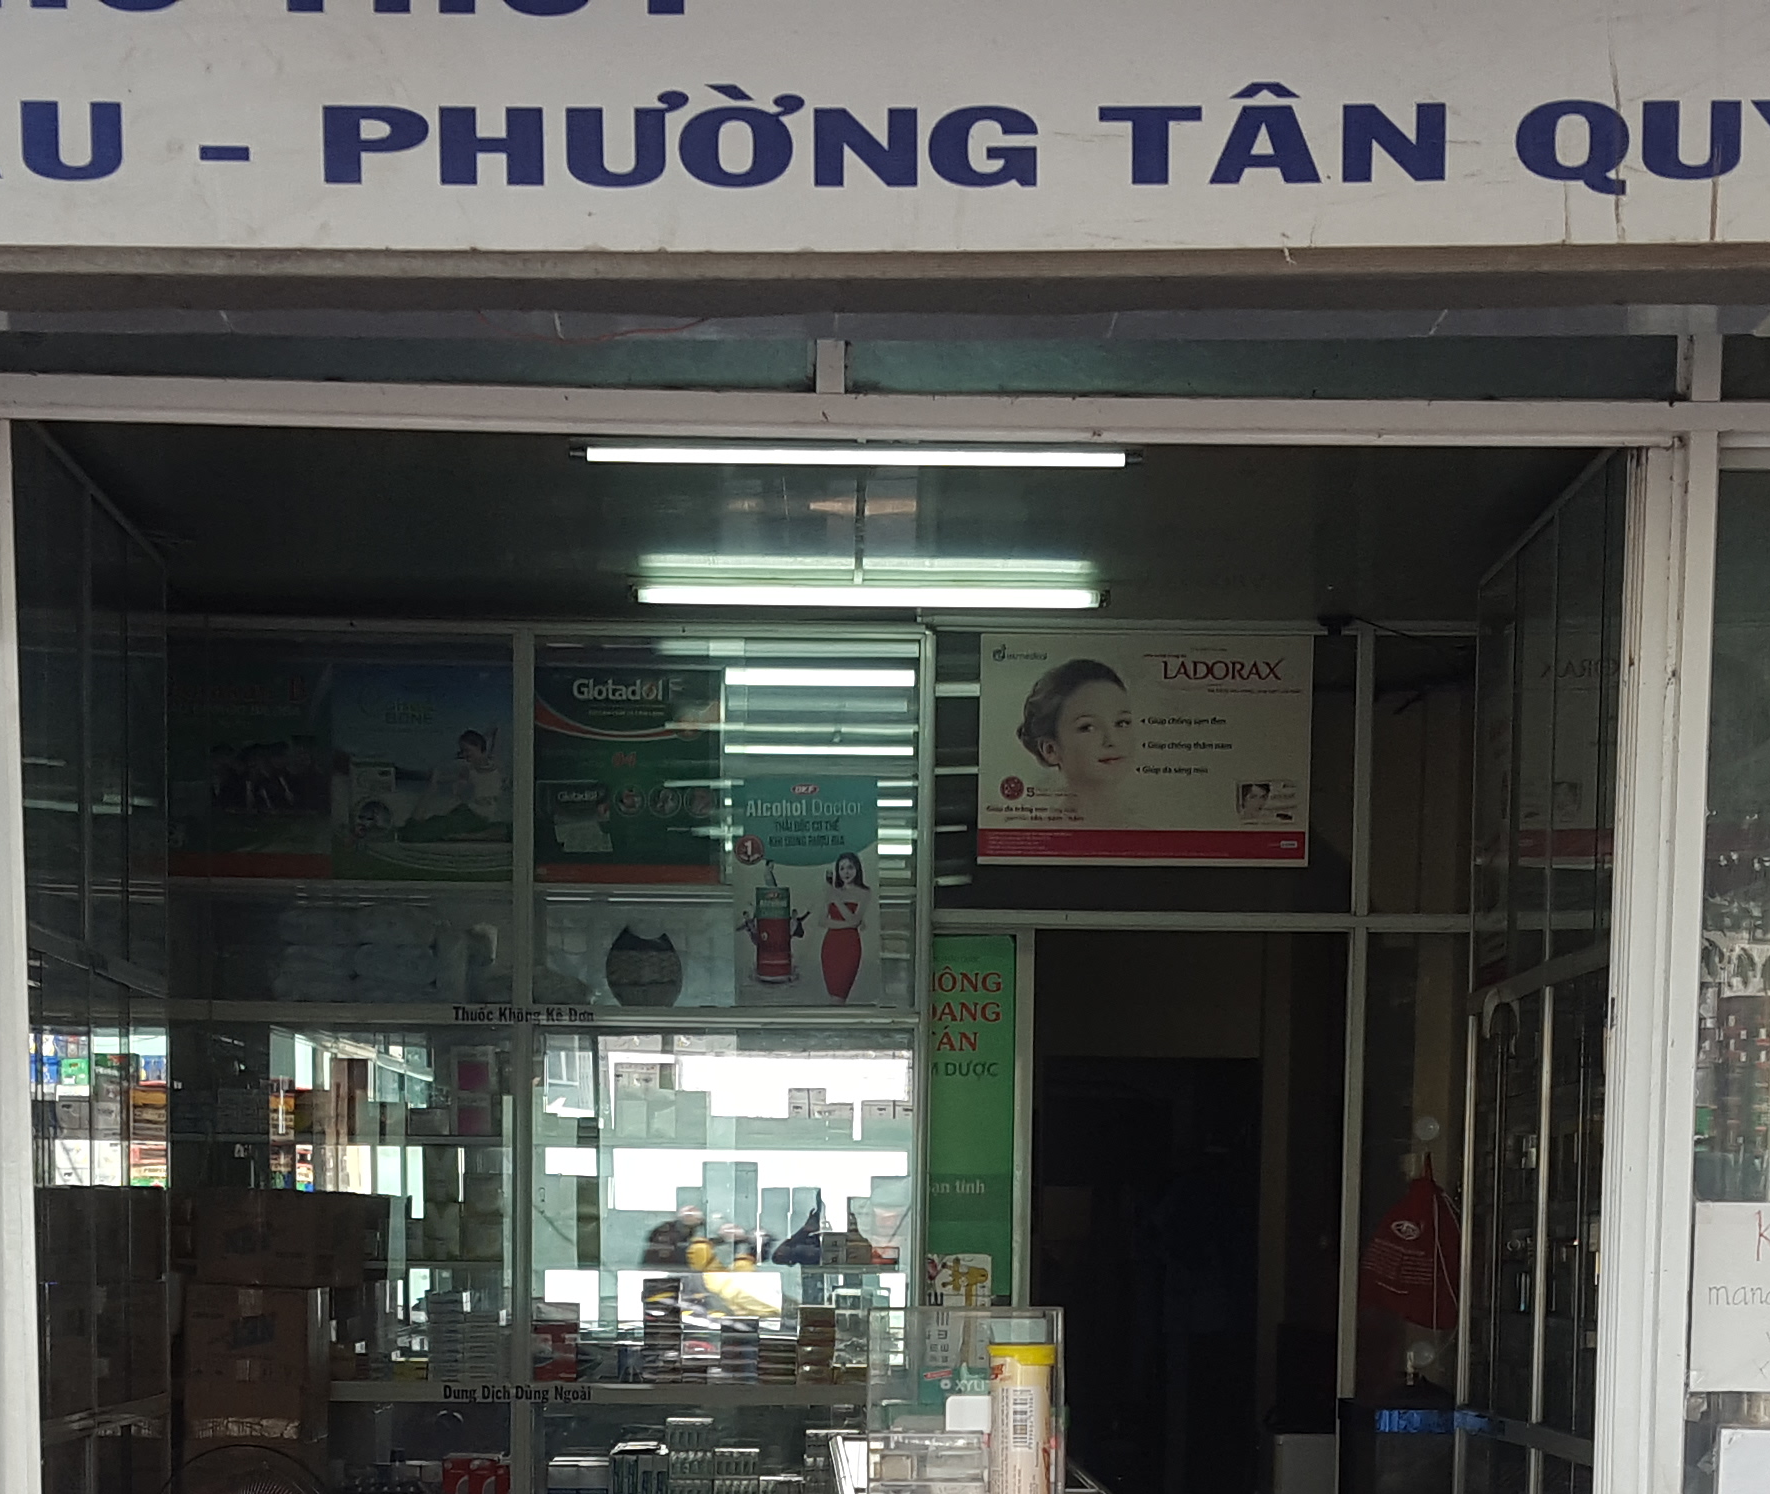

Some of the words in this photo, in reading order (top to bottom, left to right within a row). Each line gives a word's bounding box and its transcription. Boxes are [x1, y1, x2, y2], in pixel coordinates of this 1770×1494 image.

[321, 90, 1037, 188] PHƯỜNG
[1099, 82, 1445, 184] TÂN
[1162, 657, 1285, 681] LADORAX
[572, 678, 662, 700] Glotadol
[746, 799, 806, 817] Alcohol
[812, 799, 861, 816] Doctor
[453, 1005, 494, 1023] Thuốc
[497, 1005, 538, 1027] Không
[546, 1006, 563, 1022] Kê
[567, 1006, 595, 1023] Đơn
[945, 1062, 998, 1080] DƯỢC
[443, 1385, 477, 1402] Dung
[481, 1385, 511, 1402] Dịch
[515, 1384, 549, 1402] Dùng
[554, 1385, 591, 1402] Ngoài
